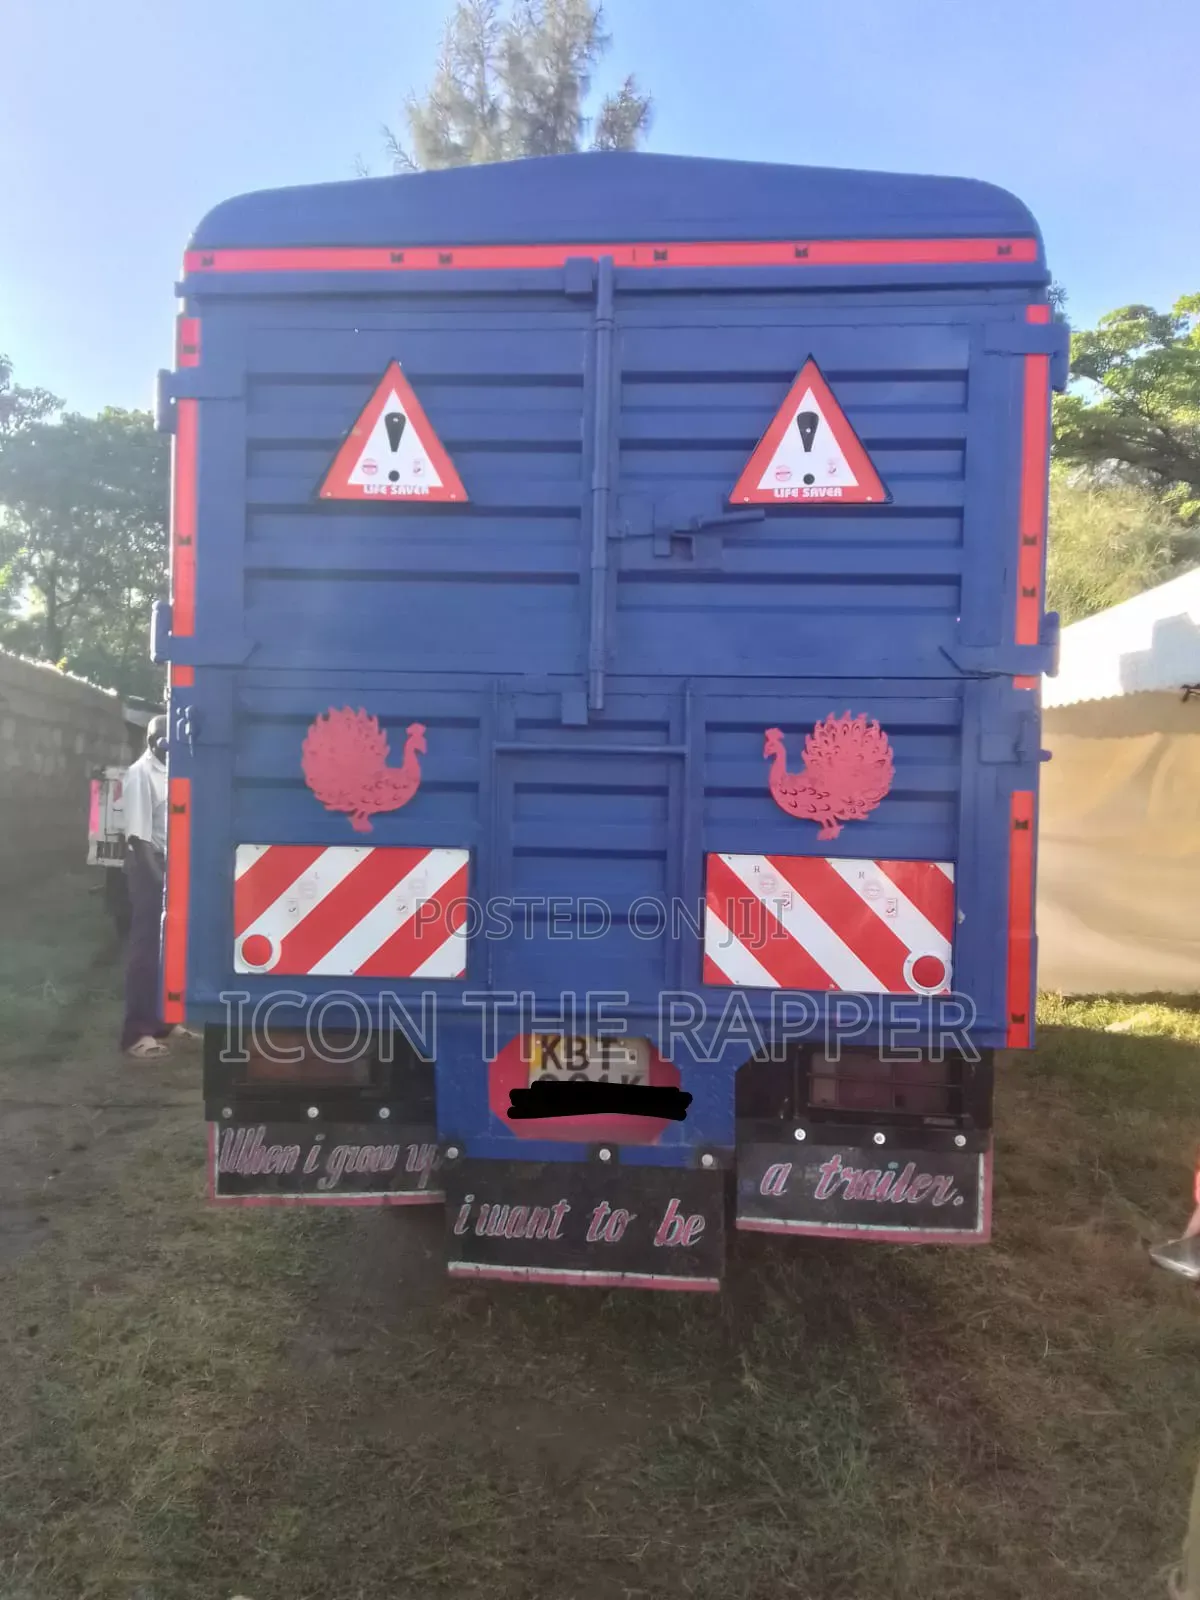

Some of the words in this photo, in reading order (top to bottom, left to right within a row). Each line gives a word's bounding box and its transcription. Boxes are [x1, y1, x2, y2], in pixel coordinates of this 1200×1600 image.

[773, 487, 799, 498] LIFE
[802, 487, 843, 498] SAVER
[540, 1036, 618, 1071] KBT
[218, 1125, 300, 1175] When
[303, 1133, 325, 1174] i
[316, 1144, 400, 1190] grow
[760, 1162, 793, 1197] a
[814, 1154, 964, 1207] trailer.
[454, 1194, 475, 1236] i
[475, 1199, 571, 1240] want
[586, 1200, 638, 1242] to
[653, 1198, 706, 1247] be
